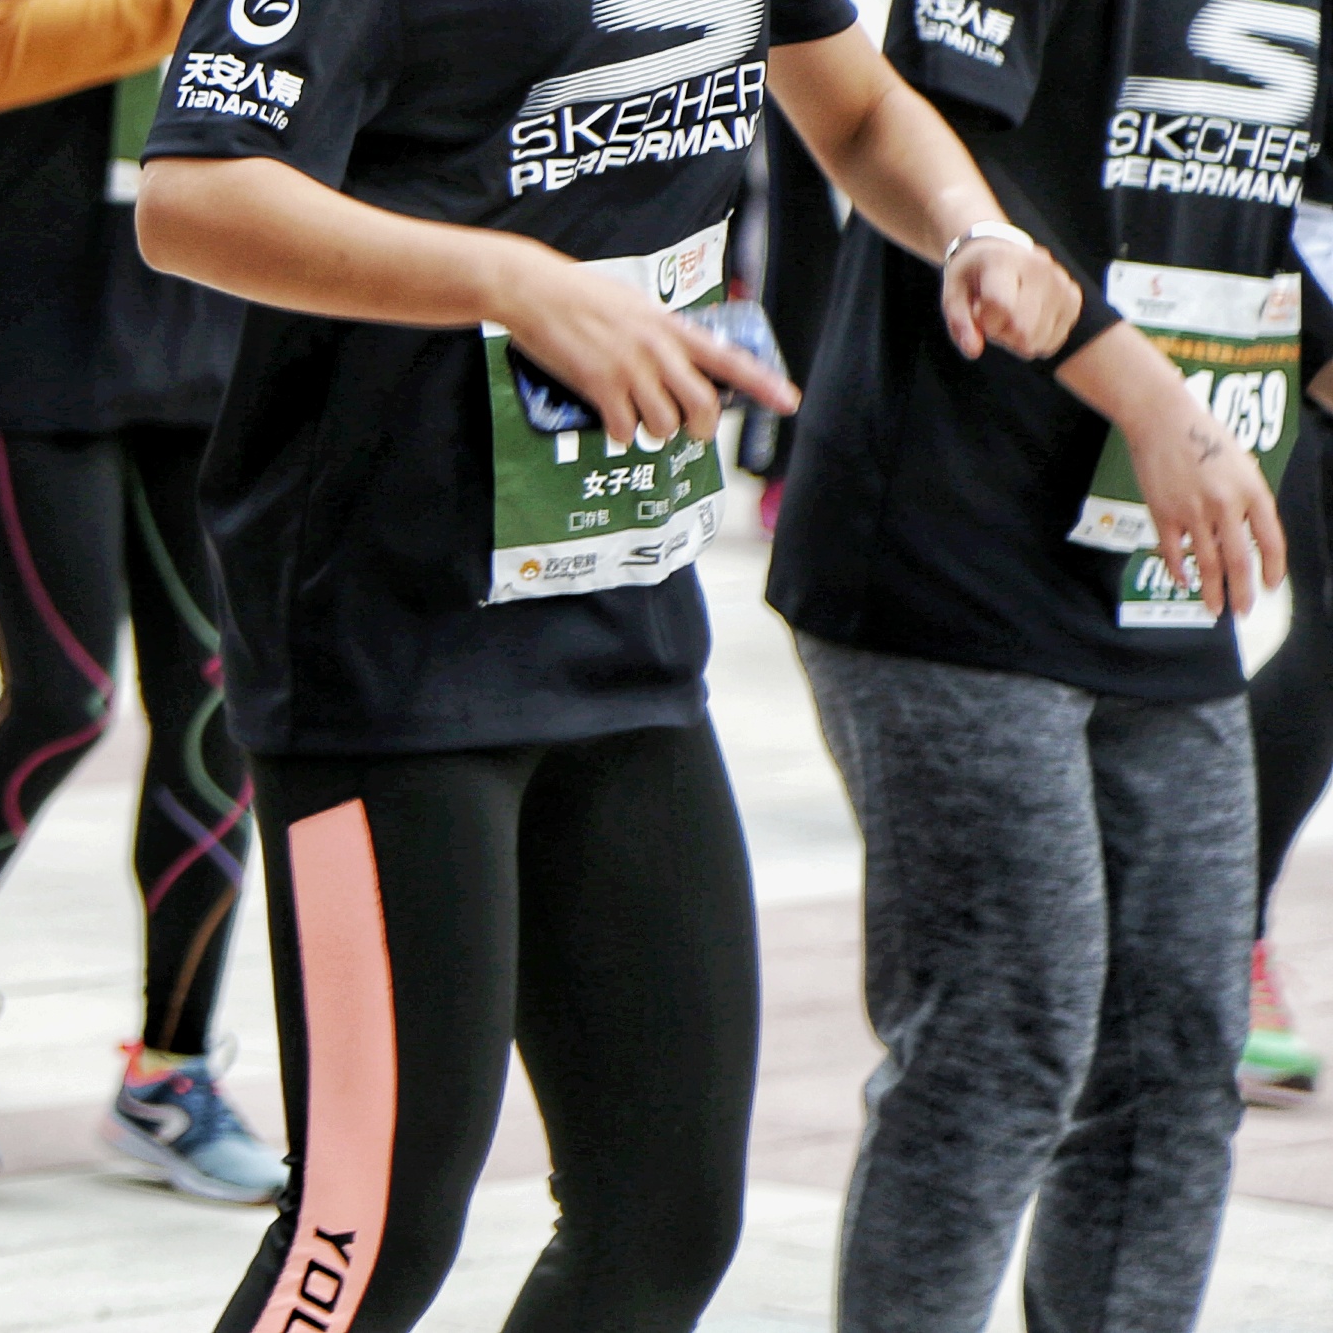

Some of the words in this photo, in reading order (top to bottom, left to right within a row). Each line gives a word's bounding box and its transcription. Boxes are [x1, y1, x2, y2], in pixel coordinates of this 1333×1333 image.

[180, 52, 305, 108] 天安人寿
[176, 84, 259, 117] TianAn
[259, 104, 289, 131] Life
[582, 463, 655, 501] 女子组
